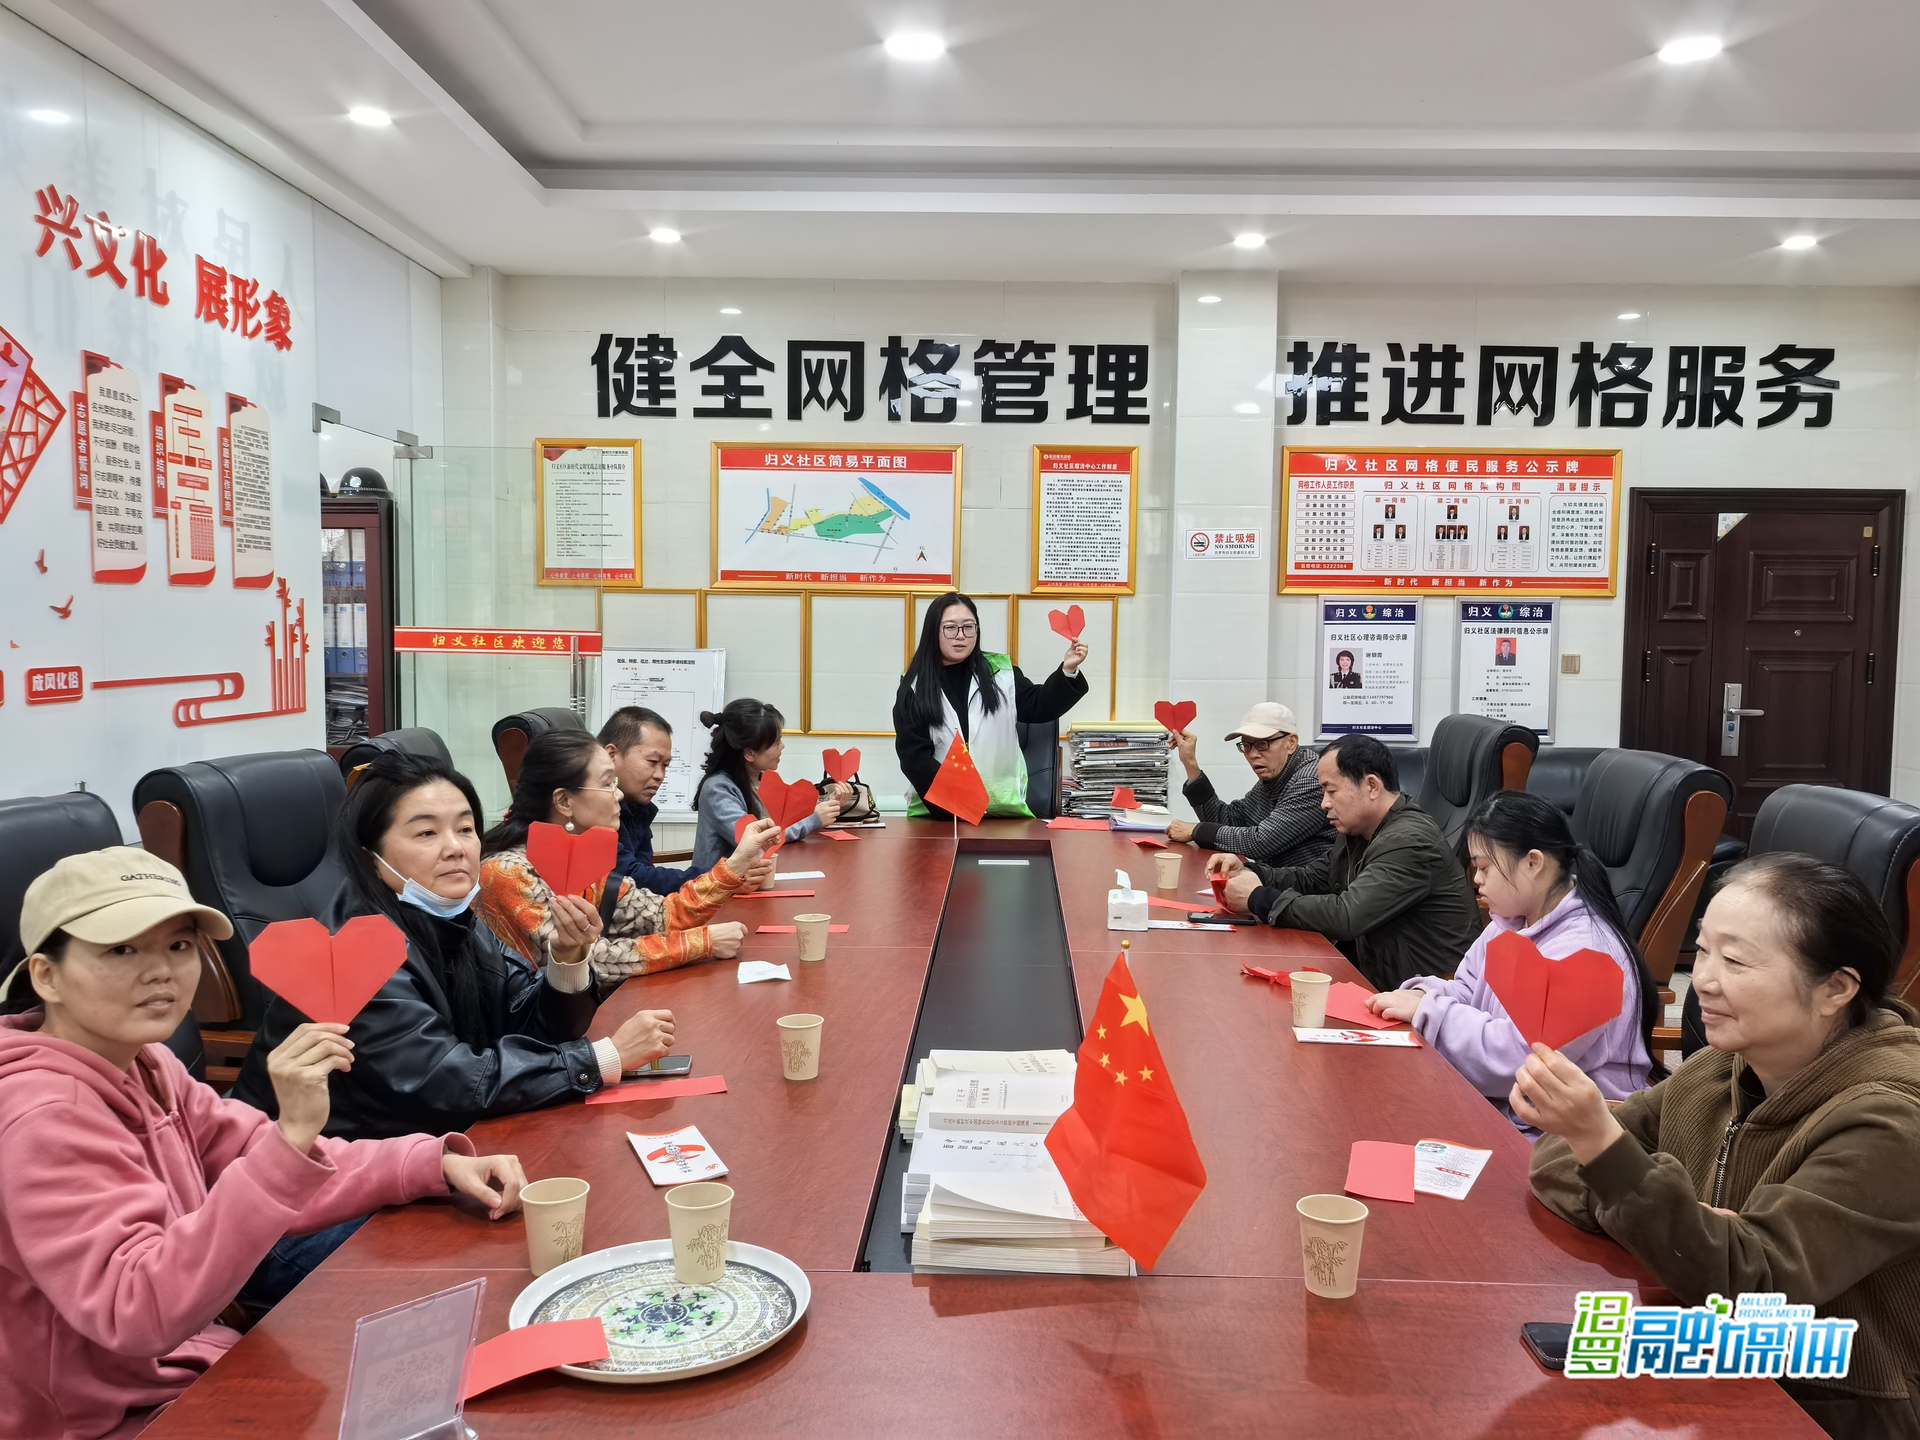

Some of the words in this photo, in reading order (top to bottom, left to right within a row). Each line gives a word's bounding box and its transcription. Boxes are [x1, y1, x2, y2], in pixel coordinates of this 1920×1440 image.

[34, 184, 170, 307] 兴文化
[195, 253, 293, 352] 展形象
[591, 333, 1150, 424] 健全网格管理
[1285, 340, 1840, 430] 推进网格服务
[764, 453, 907, 469] 归义社区简易平面图
[1325, 459, 1579, 473] 归义社区网格便民服务公示牌
[1384, 481, 1521, 491] 归义社区网格架构图
[1557, 482, 1601, 491] 温馨提示
[1215, 533, 1255, 543] 禁止吸烟
[785, 572, 812, 581] 新时代
[820, 573, 847, 581] 新担当
[859, 574, 886, 582] 新作为
[1384, 578, 1418, 586] 新时代
[1432, 578, 1466, 587] 新担当
[1479, 579, 1513, 587] 新作为
[1335, 607, 1357, 617] 归义
[1382, 608, 1404, 617] 综治
[1468, 606, 1492, 617] 归义
[1519, 606, 1543, 618] 综治
[432, 634, 565, 650] 归义社区欢迎您
[32, 671, 79, 691] 成风化俗
[120, 872, 181, 887] GATHERING
